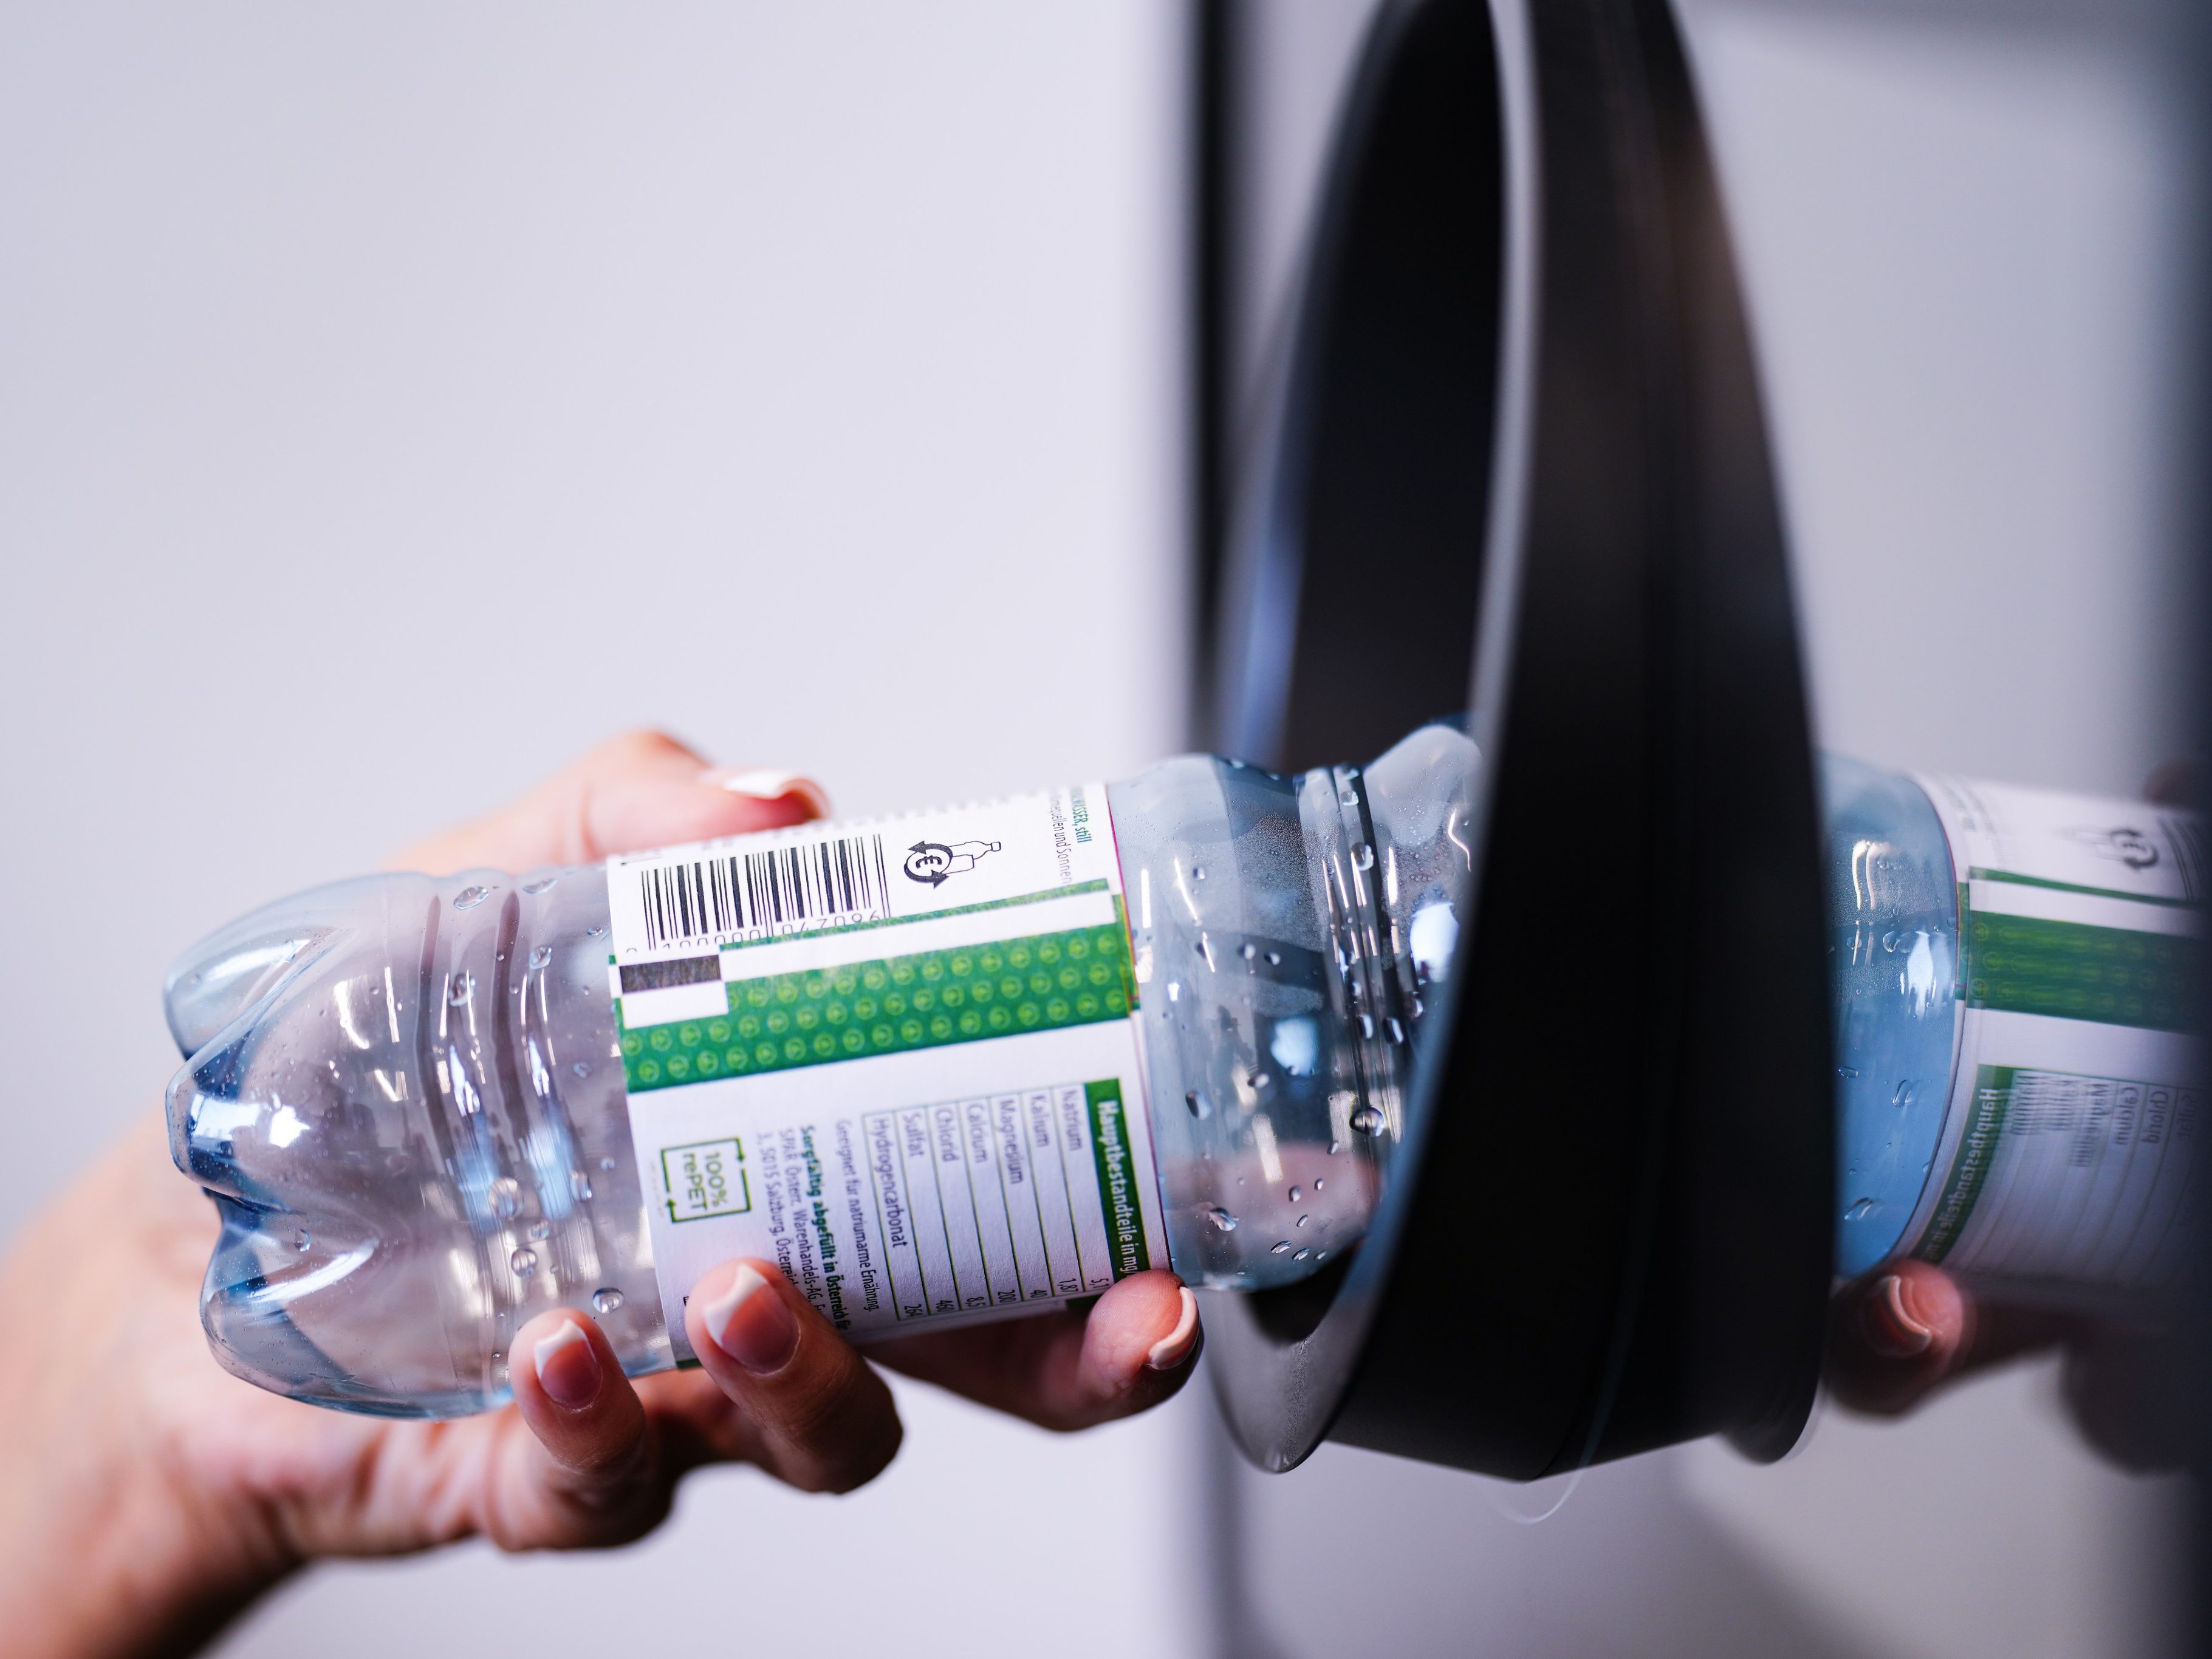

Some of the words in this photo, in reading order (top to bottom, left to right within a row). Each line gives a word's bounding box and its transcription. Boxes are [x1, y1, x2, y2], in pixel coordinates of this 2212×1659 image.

[1055, 832, 1072, 847] und
[1075, 827, 1092, 843] still
[778, 1128, 798, 1162] SPAR
[836, 1118, 857, 1177] Geeignet
[903, 1112, 926, 1157] Sulfat
[1062, 1089, 1083, 1152] Natrium
[683, 1152, 708, 1211] rePET
[705, 1151, 728, 1208] 100%
[759, 1148, 781, 1179] 5015
[801, 1124, 824, 1197] Sorgfältig
[846, 1178, 861, 1196] für
[868, 1118, 908, 1248] Hydrogencarbonat
[1097, 1100, 1137, 1242] Hauptbestandteile
[1121, 1243, 1139, 1256] in
[765, 1182, 786, 1236] Salzburg,
[934, 1107, 960, 1163] Chlorid
[965, 1296, 987, 1307] 8,5
[966, 1103, 988, 1163] Calcium
[998, 1288, 1017, 1304] 200
[994, 1098, 1024, 1185] Magnesium
[1030, 1289, 1048, 1299] 40
[1030, 1095, 1050, 1148] Kalium
[1056, 1278, 1078, 1292] 1,87
[811, 1200, 837, 1261] abgefüllt
[849, 1199, 871, 1268] natriumarme
[823, 1260, 839, 1273] in
[861, 1269, 881, 1312] Ernährung.
[826, 1274, 850, 1320] Österreich
